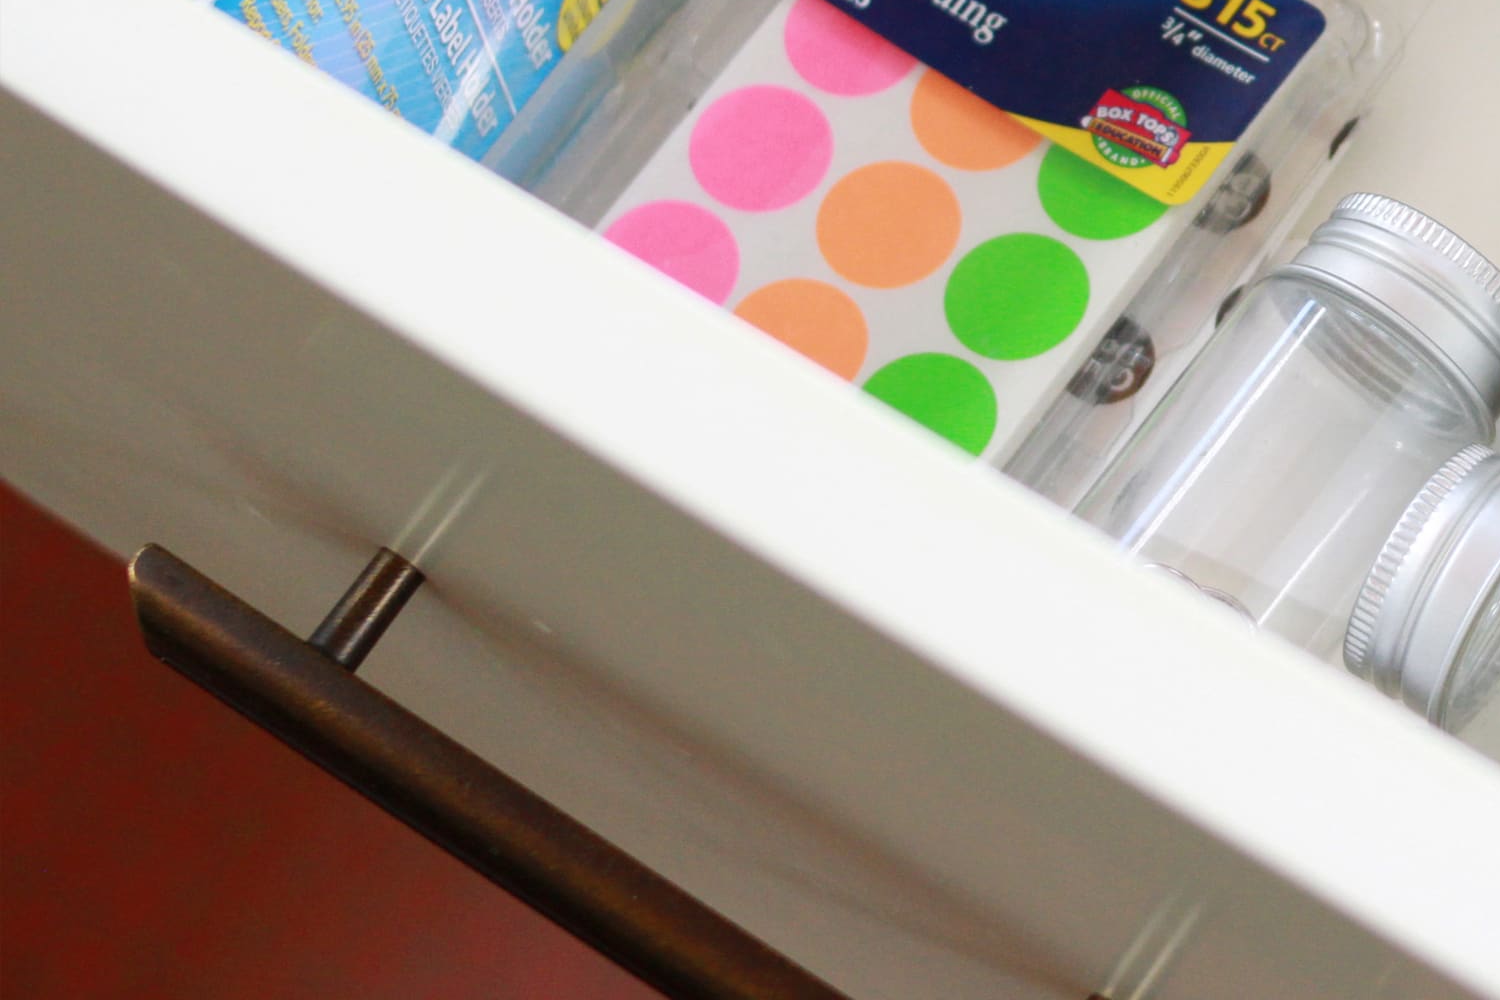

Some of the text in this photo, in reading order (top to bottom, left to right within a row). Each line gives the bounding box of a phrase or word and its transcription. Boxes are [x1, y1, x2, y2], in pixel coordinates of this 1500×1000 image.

[1190, 42, 1257, 86] diameter
[464, 57, 499, 138] Holder
[1130, 88, 1181, 121] OFFICIAL
[1096, 105, 1176, 145] BOX TOPS
[1098, 141, 1138, 165] BRAND
